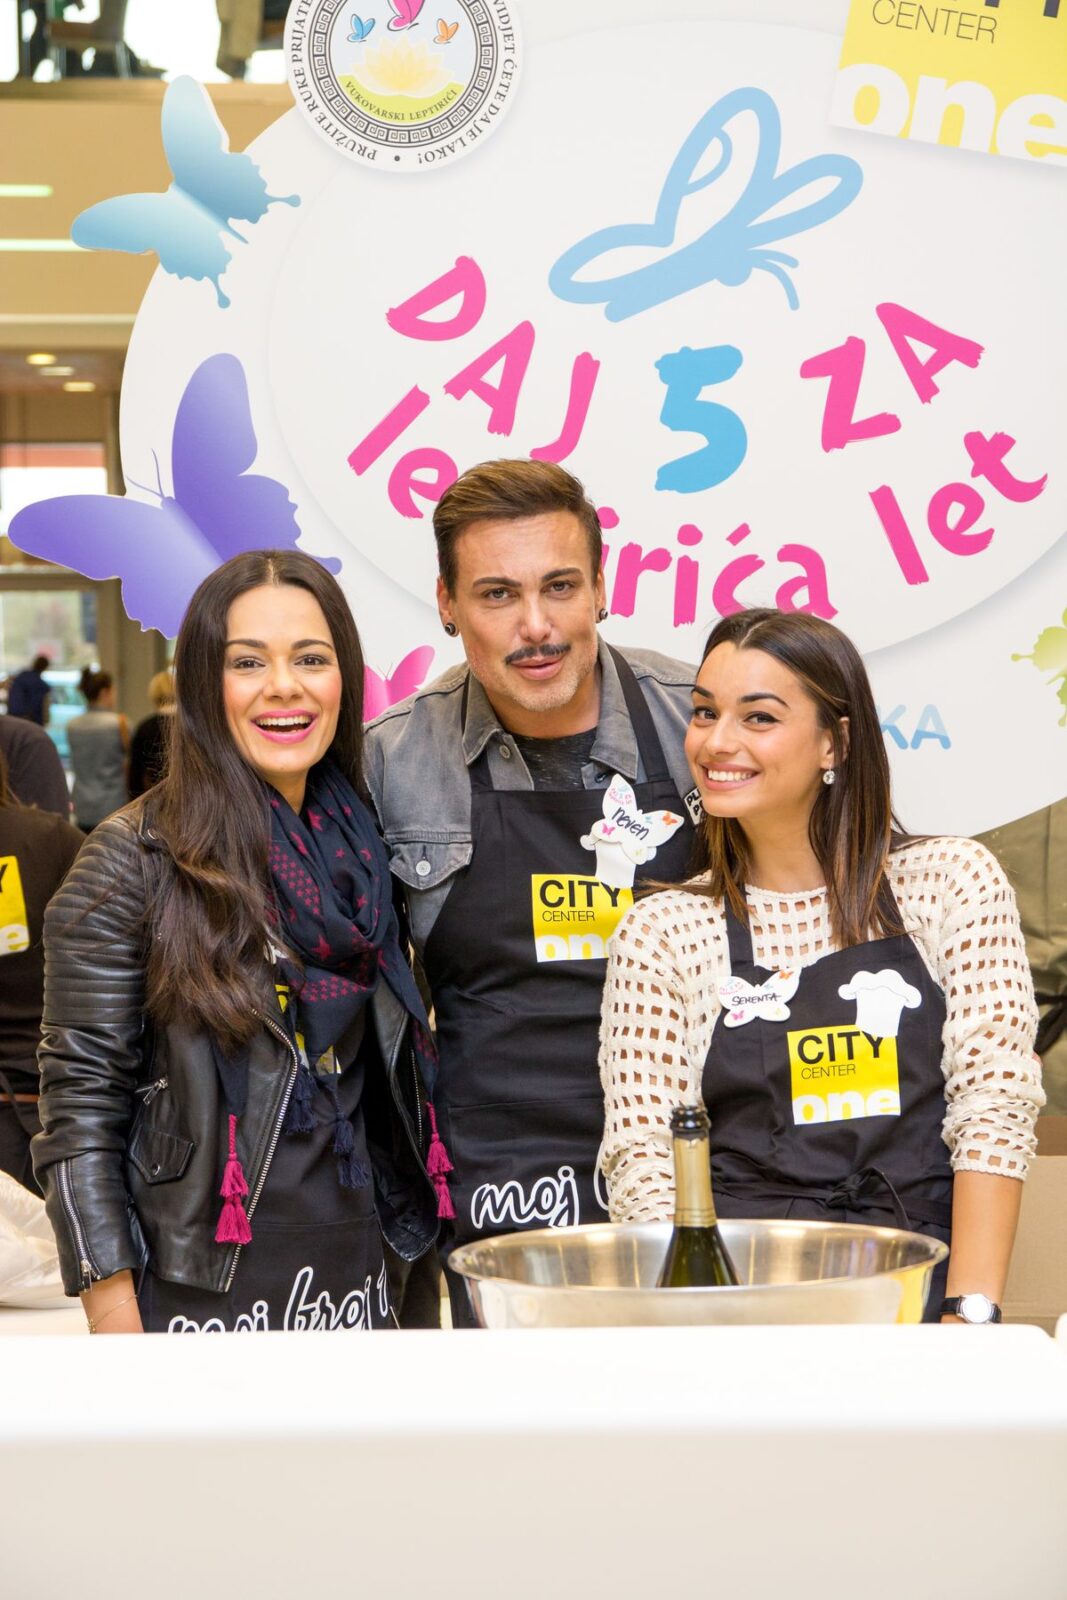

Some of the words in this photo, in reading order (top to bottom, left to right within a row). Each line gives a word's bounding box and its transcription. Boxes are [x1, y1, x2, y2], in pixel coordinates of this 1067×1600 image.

[872, 0, 998, 44] CENTER
[293, 67, 319, 113] RUKE
[345, 81, 405, 121] VUKOVARSKI
[494, 59, 517, 102] ĆETE
[829, 62, 1067, 167] one
[314, 111, 378, 161] PRUŽITE
[417, 136, 467, 164] LAKO!
[386, 256, 601, 463] DAJ
[655, 345, 748, 493] 5
[800, 302, 985, 452] ZA
[869, 430, 1048, 585] let
[539, 879, 622, 909] CITY
[542, 910, 595, 922] CENTER
[536, 933, 610, 961] on
[797, 1029, 883, 1065] CITY
[801, 1063, 856, 1081] CENTER
[793, 1089, 901, 1125] one
[471, 1165, 580, 1229] moj
